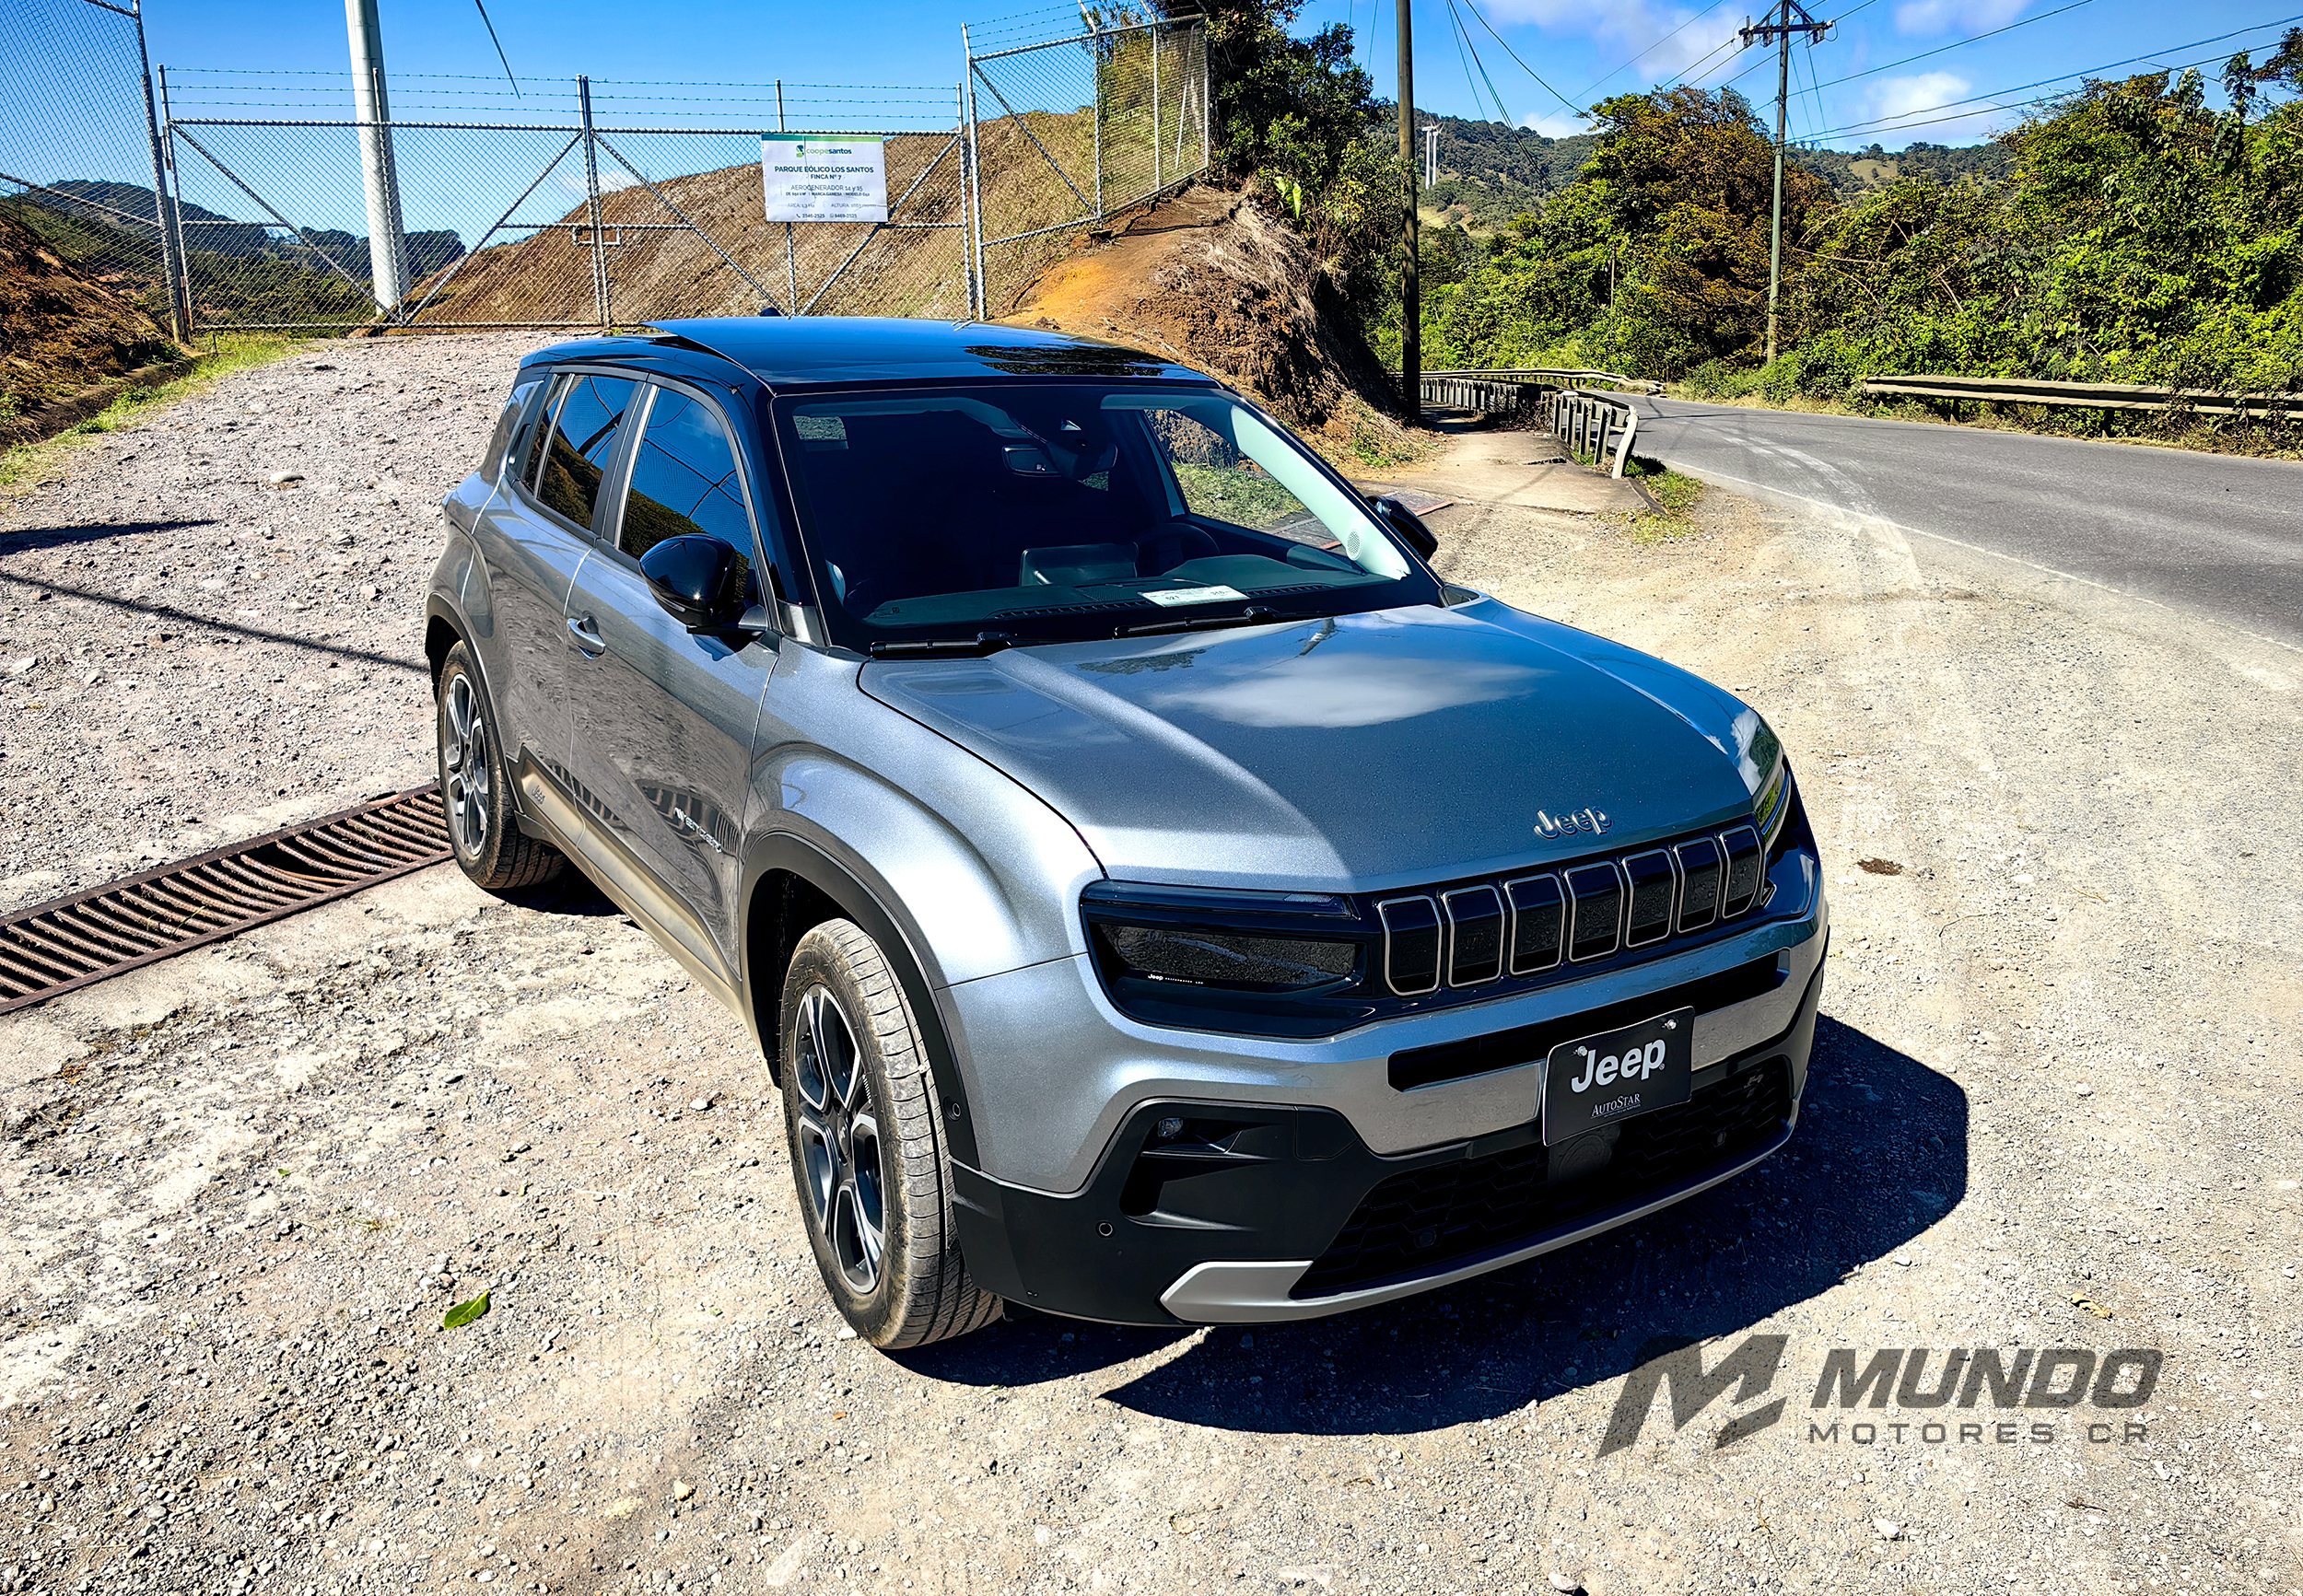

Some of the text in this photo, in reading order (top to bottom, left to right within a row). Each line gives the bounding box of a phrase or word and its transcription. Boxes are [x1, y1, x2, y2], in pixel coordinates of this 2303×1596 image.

[804, 165, 830, 173] EÓLICO
[1534, 807, 1612, 839] Jeep
[1571, 1039, 1666, 1093] Jeep
